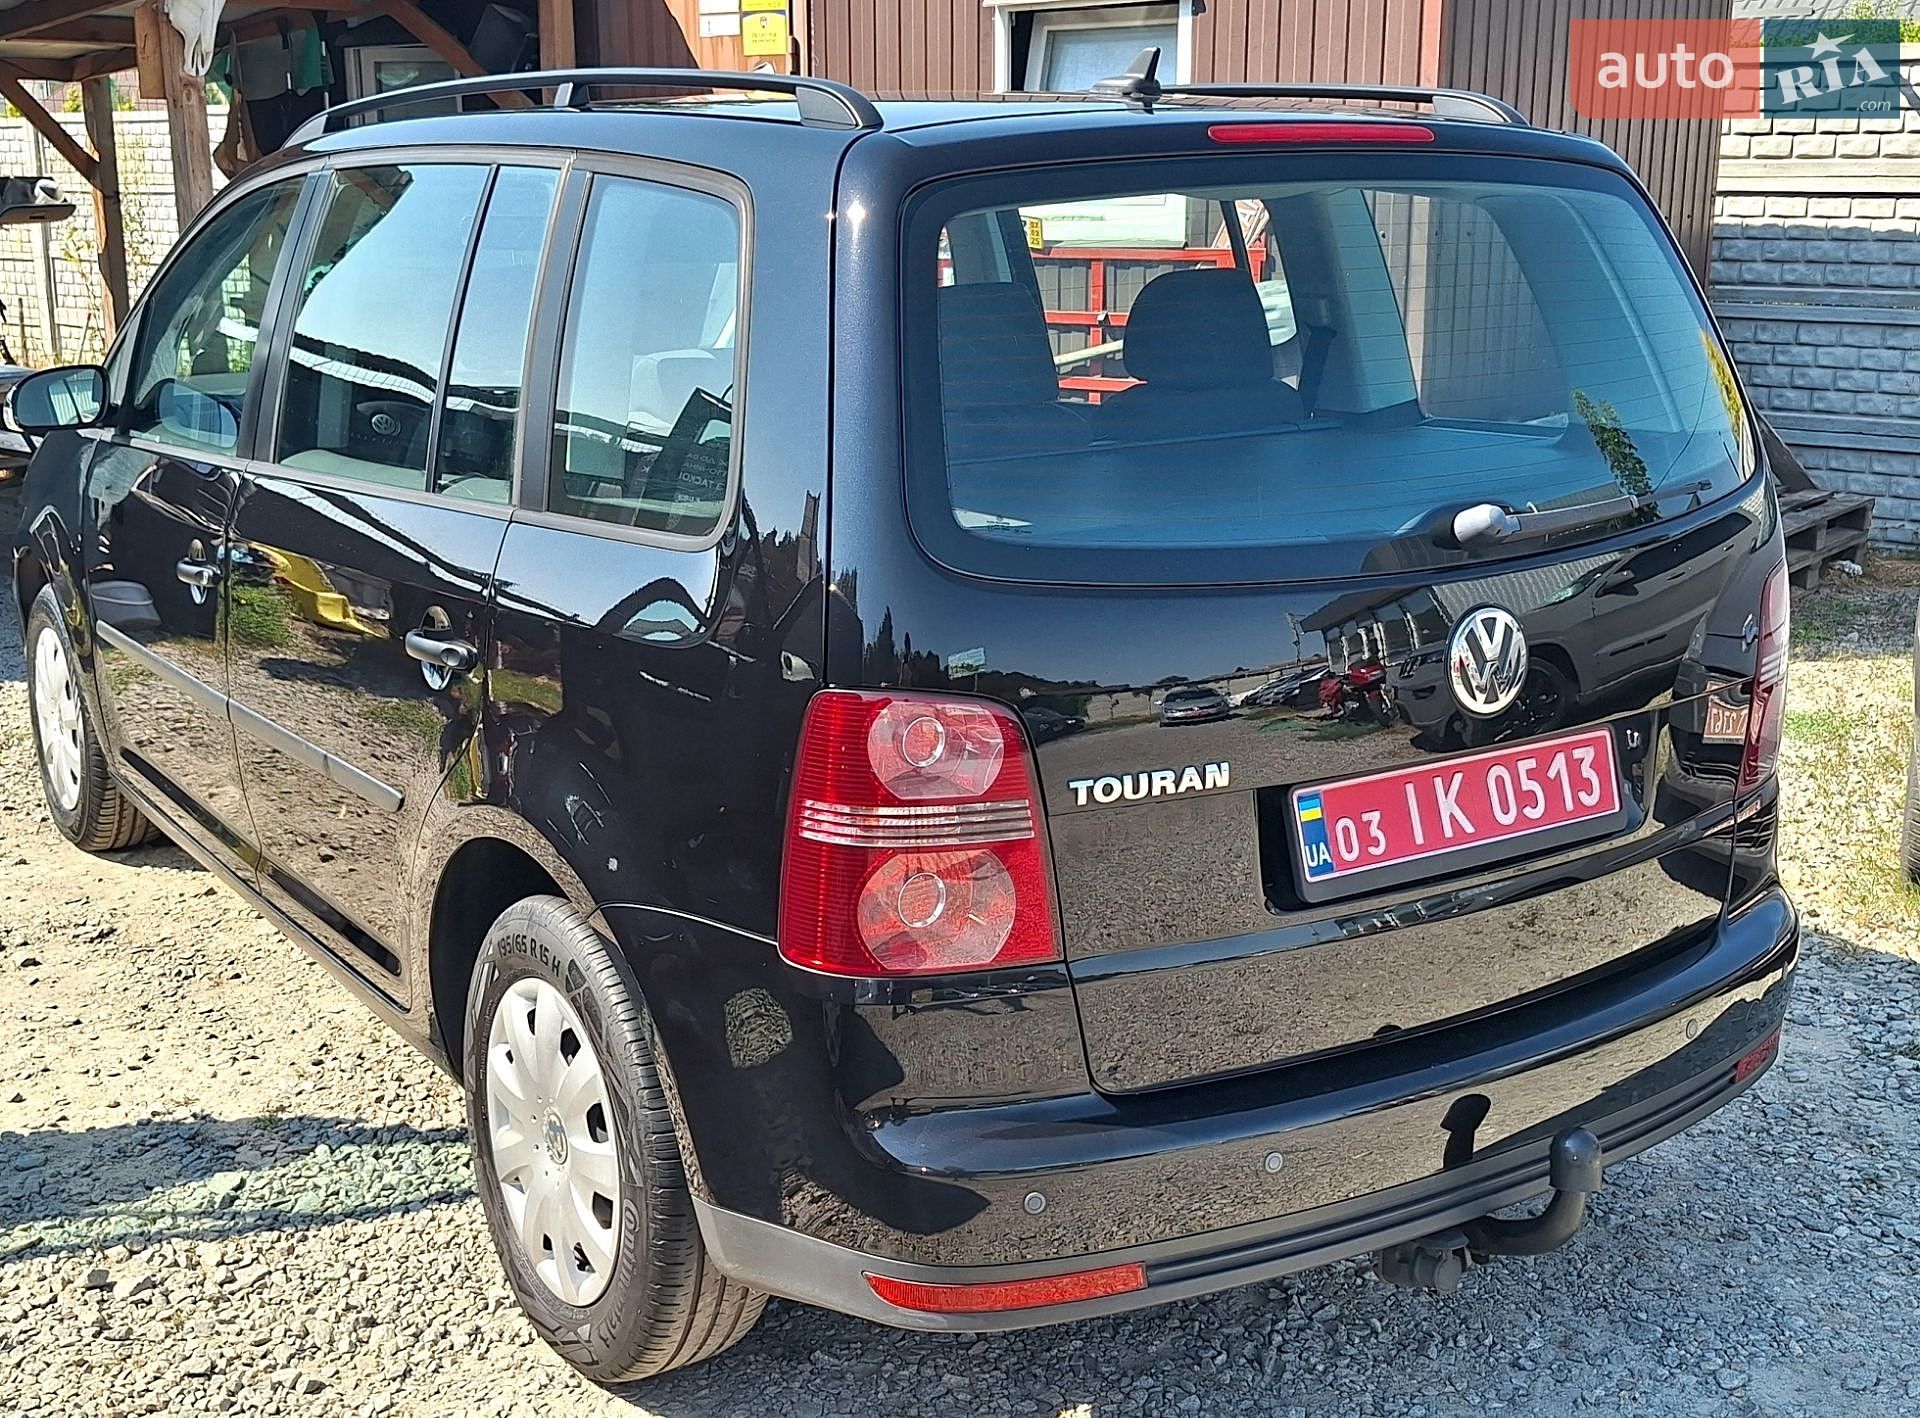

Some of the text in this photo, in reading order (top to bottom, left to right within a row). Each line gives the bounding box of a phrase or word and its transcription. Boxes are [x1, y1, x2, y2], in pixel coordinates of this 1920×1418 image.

[1069, 762, 1230, 806] TOURAN
[1335, 809, 1387, 862] 03
[1486, 745, 1601, 826] 0513
[1305, 841, 1332, 868] UA
[498, 933, 561, 977] 195/65 R 15 H
